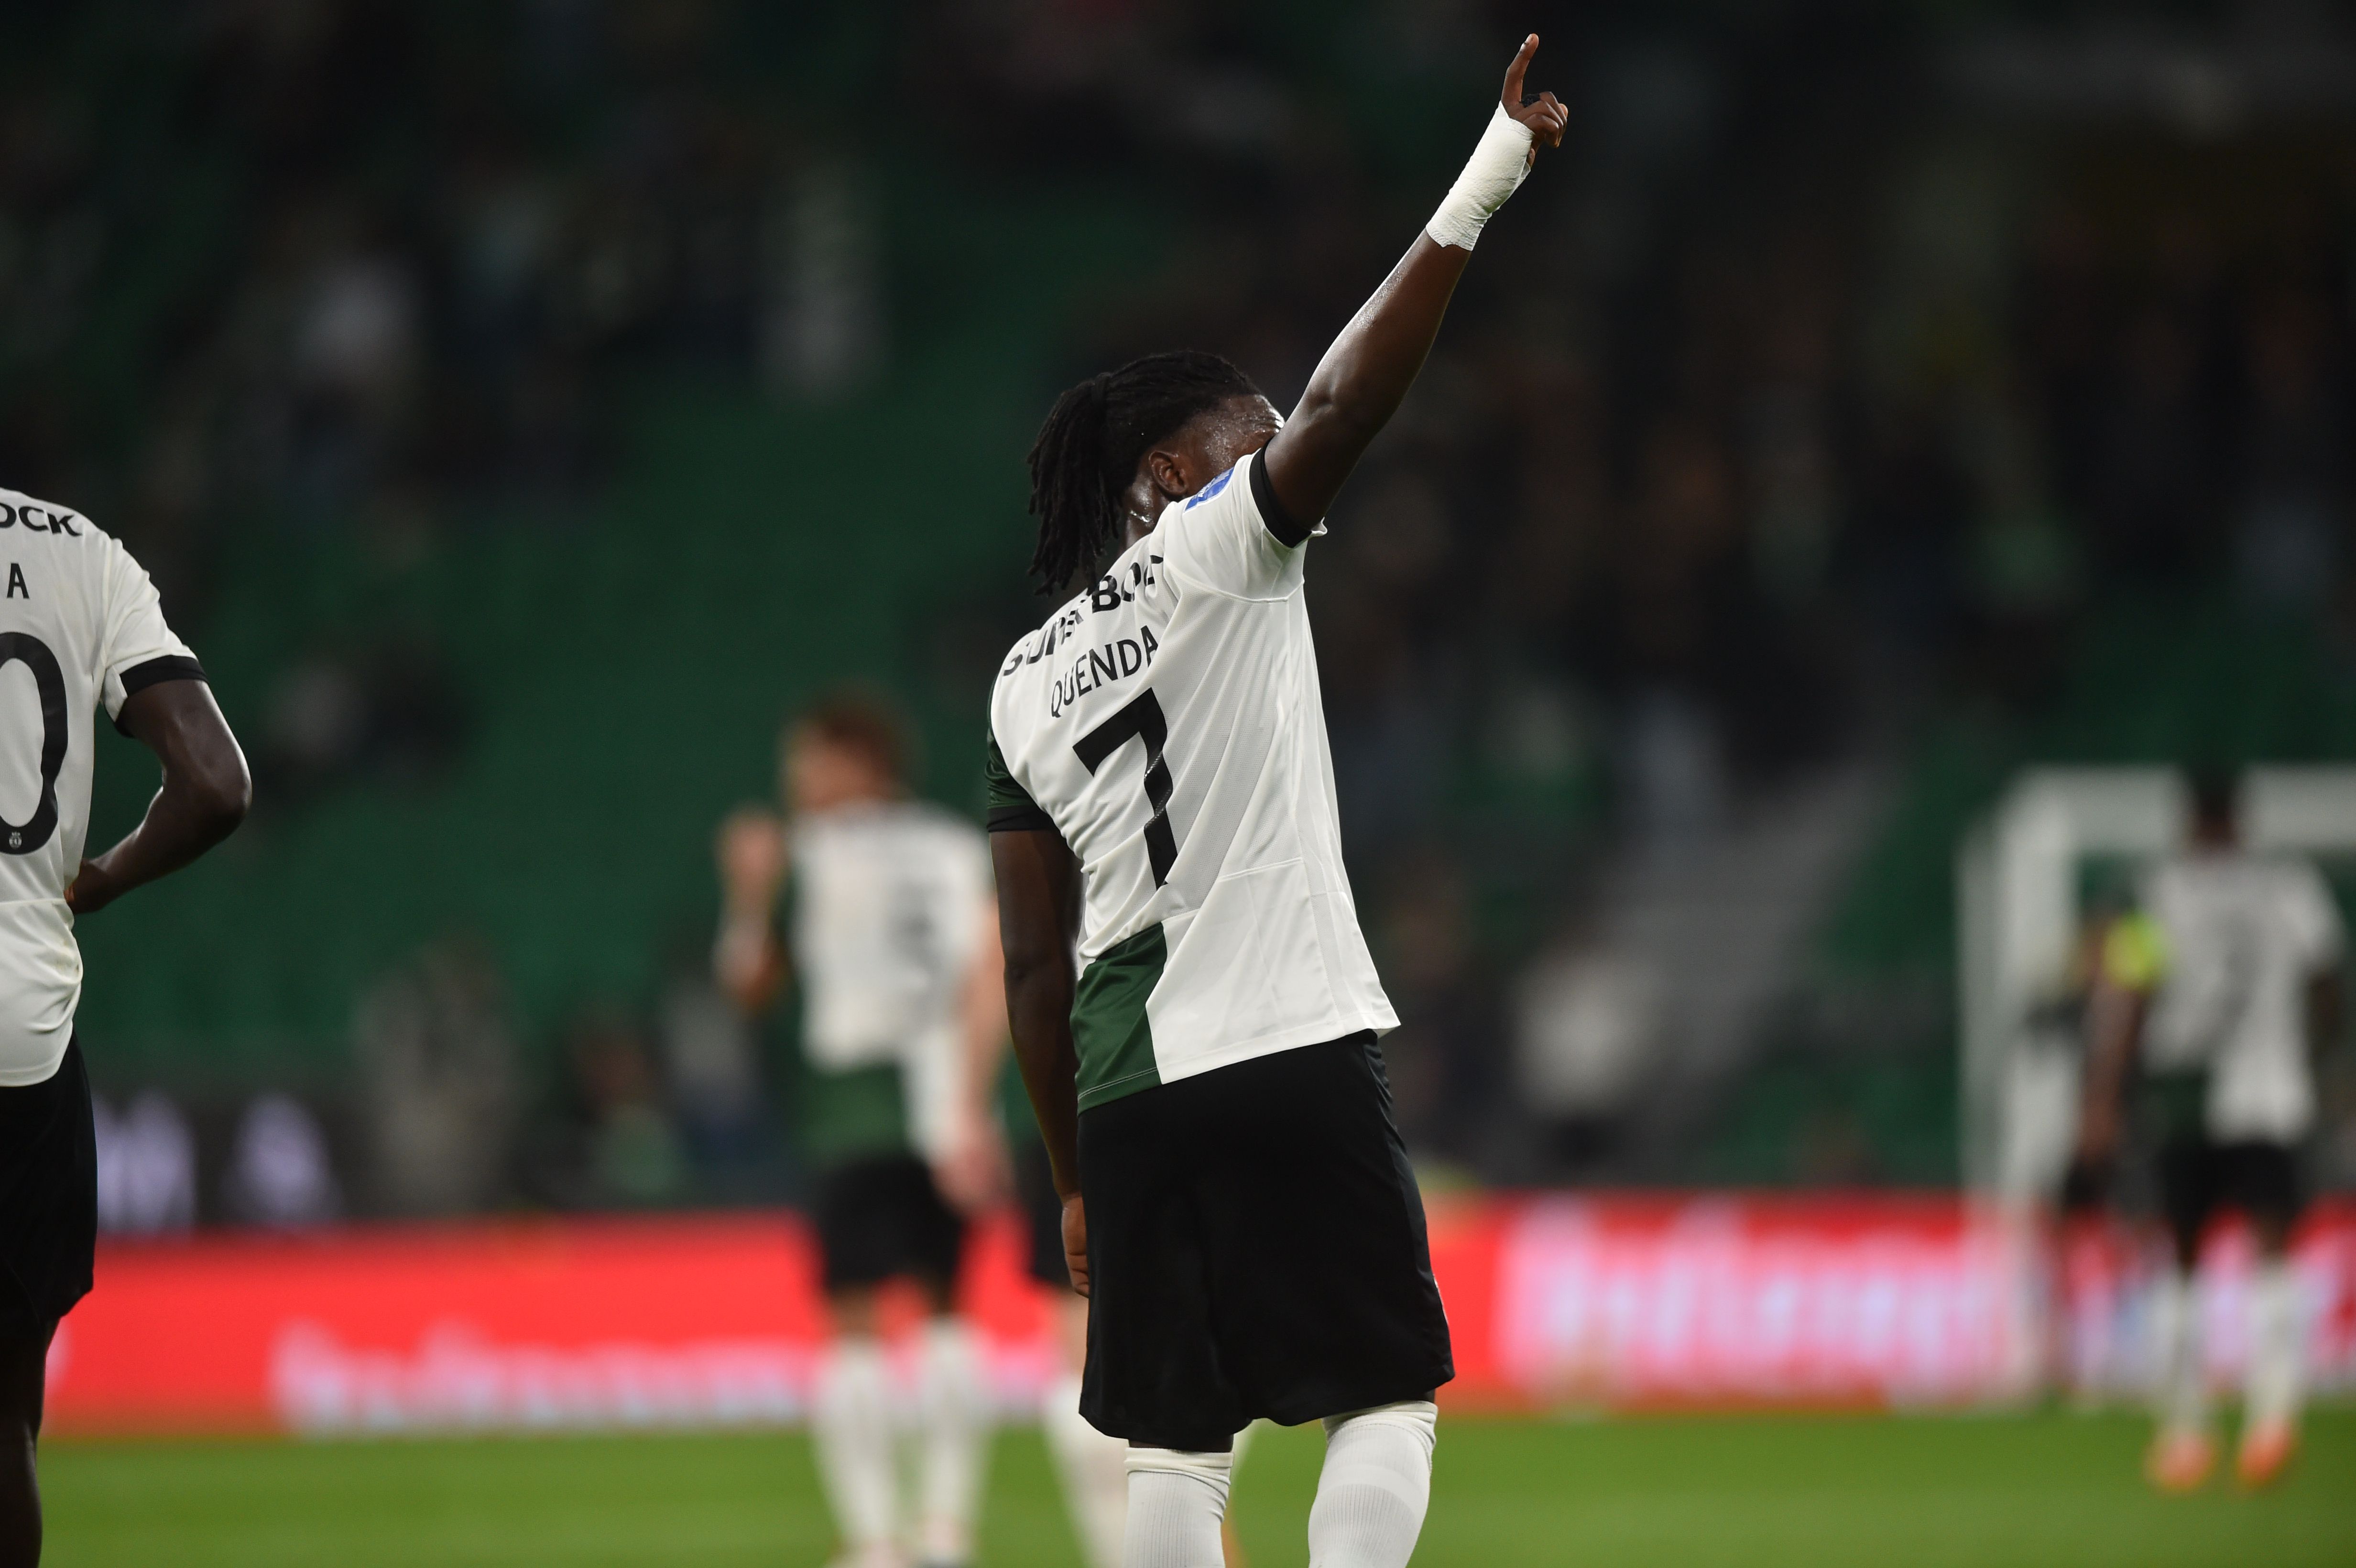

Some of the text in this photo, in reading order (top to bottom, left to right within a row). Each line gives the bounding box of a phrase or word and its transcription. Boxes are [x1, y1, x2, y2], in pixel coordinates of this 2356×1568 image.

[7, 563, 30, 599] A
[1051, 625, 1158, 718] QUENDA
[1073, 687, 1178, 891] 7
